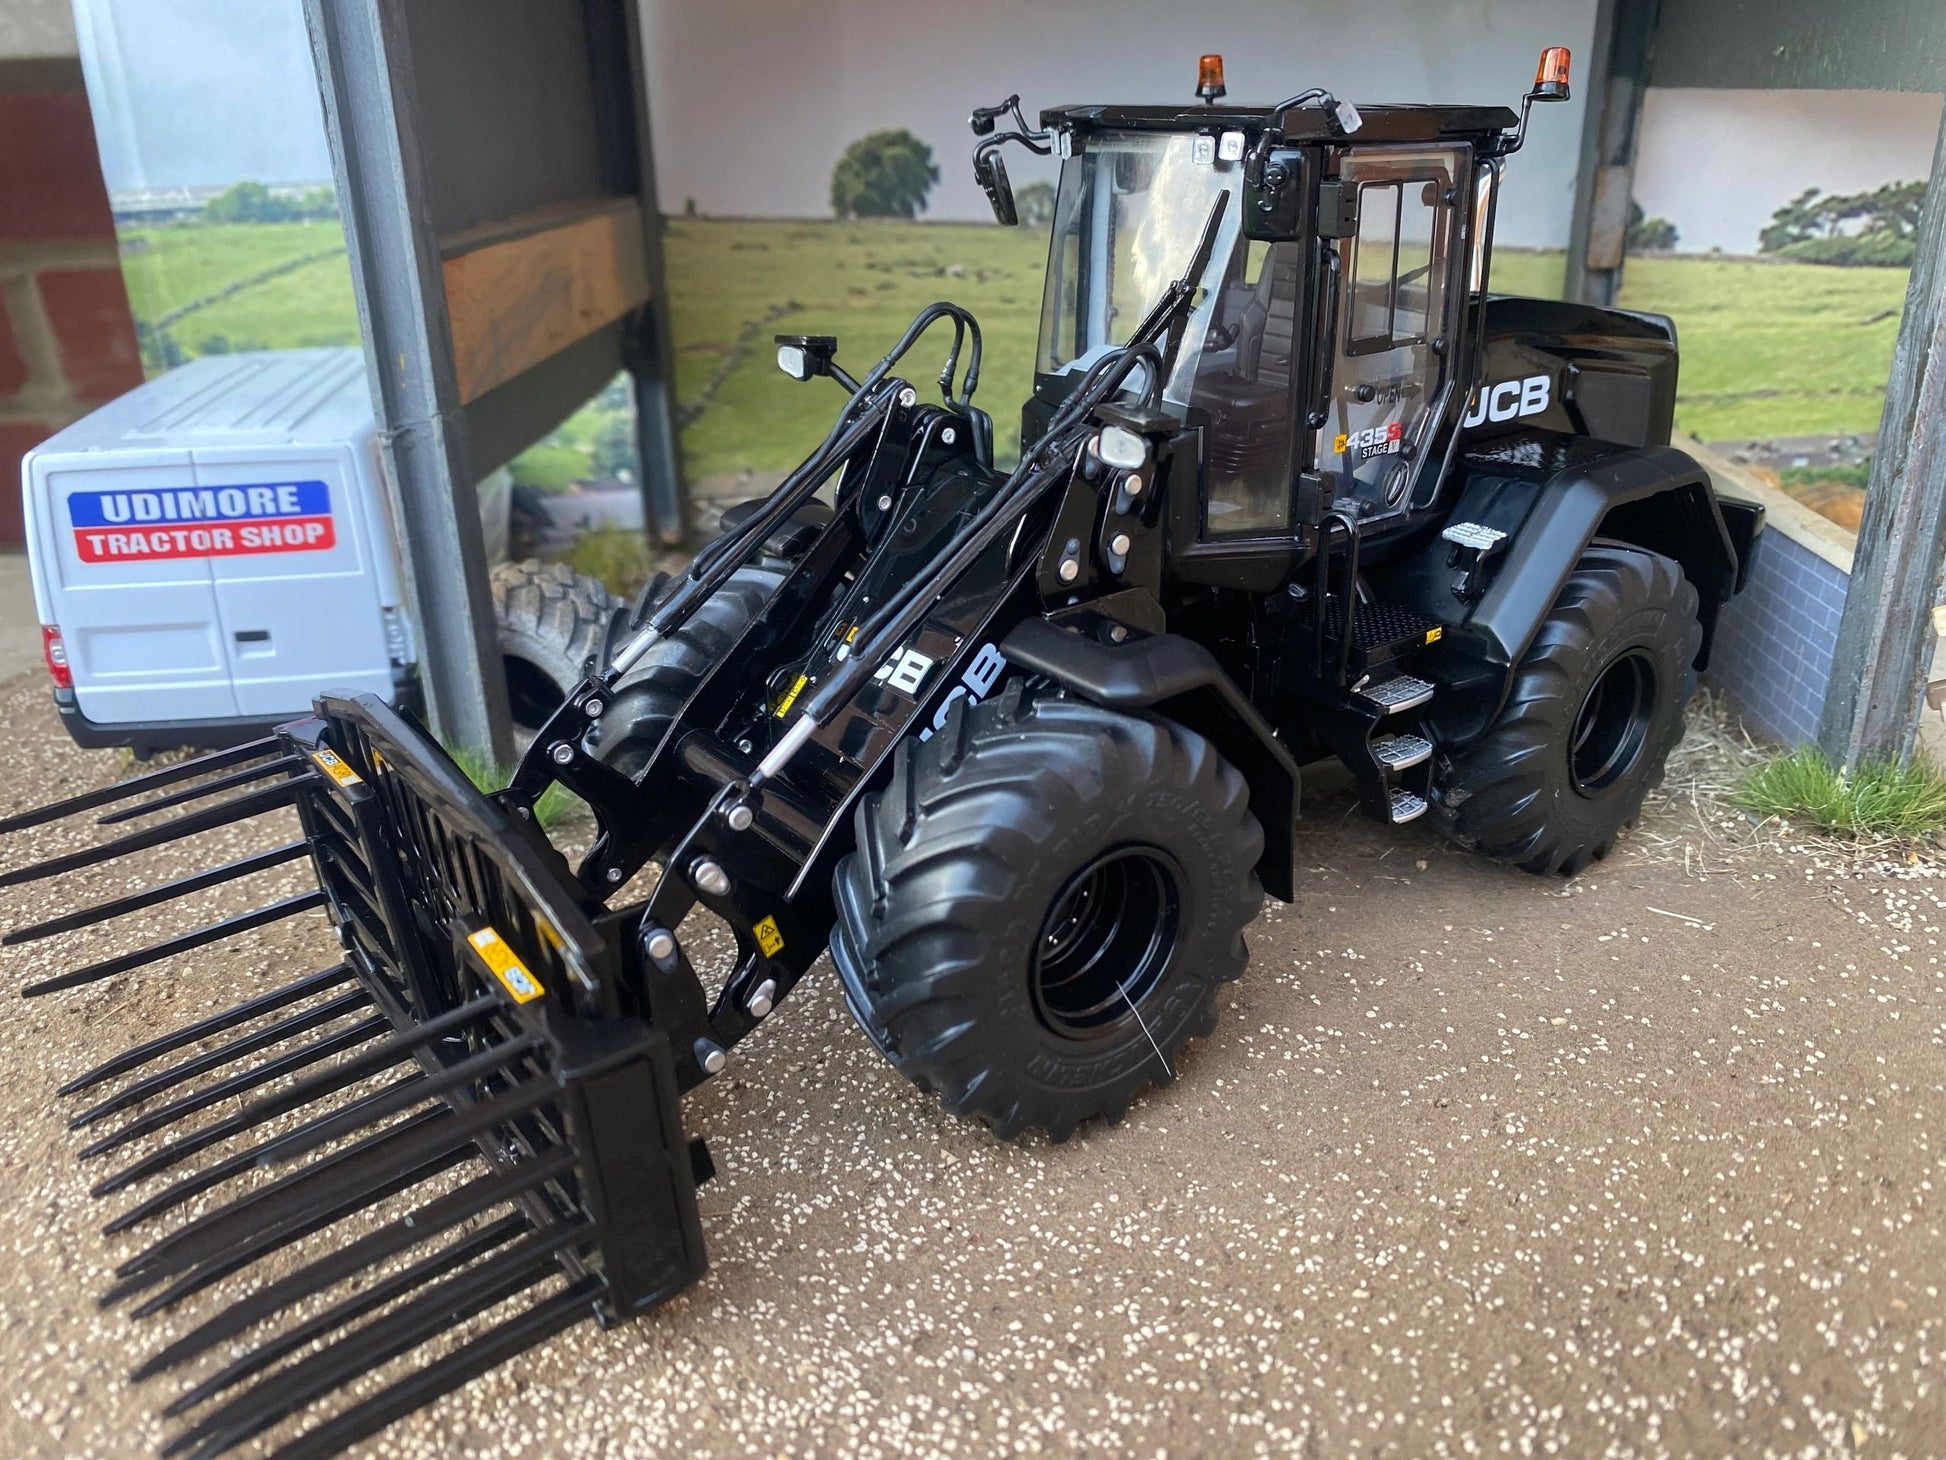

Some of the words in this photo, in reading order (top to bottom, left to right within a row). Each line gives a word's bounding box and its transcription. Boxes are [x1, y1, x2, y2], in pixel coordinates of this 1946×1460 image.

[1377, 385, 1400, 405] OPEN
[1463, 375, 1550, 428] JCB
[1346, 423, 1402, 450] 435S
[1362, 442, 1388, 458] STAGE
[100, 485, 302, 523] UDIMORE
[87, 527, 234, 556] TRACTOR
[240, 523, 325, 548] SHOP
[919, 642, 1007, 742] CB
